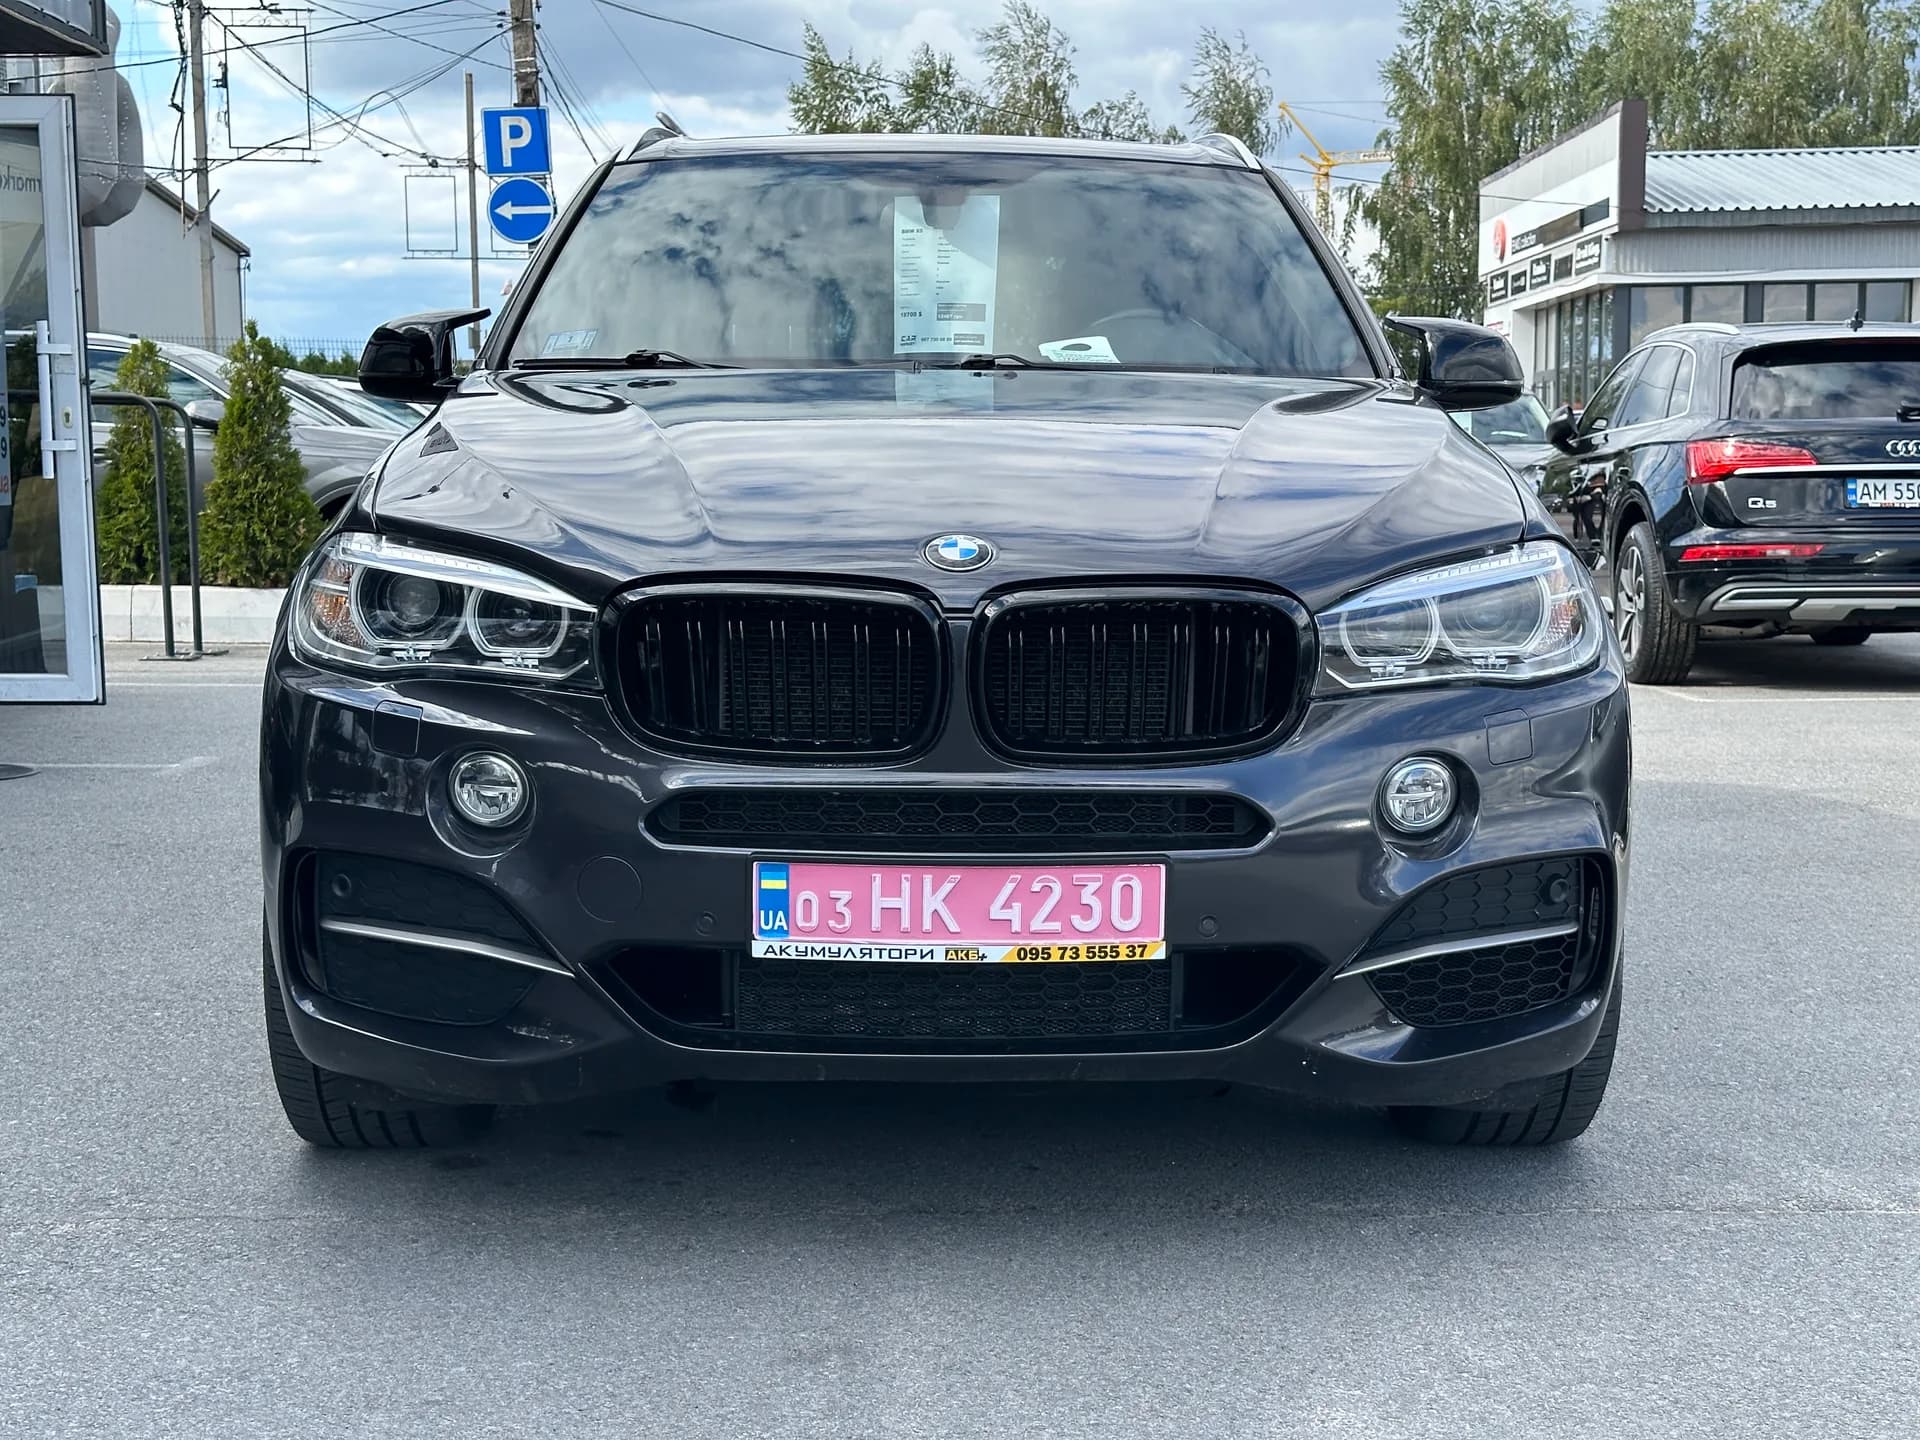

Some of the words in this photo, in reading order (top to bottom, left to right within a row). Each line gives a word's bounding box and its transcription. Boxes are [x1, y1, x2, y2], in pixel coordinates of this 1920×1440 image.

[500, 116, 532, 167] P
[1860, 482, 1887, 501] AM
[1748, 497, 1777, 508] Q5
[760, 910, 788, 931] UA
[795, 890, 853, 934] 03
[871, 873, 962, 934] HK
[989, 873, 1143, 934] 4230
[763, 944, 935, 960] АКУМУЛЯТОРИ
[1016, 947, 1052, 961] 095
[1057, 946, 1081, 960] 73
[1085, 945, 1123, 960] 555
[1125, 943, 1148, 958] 37
